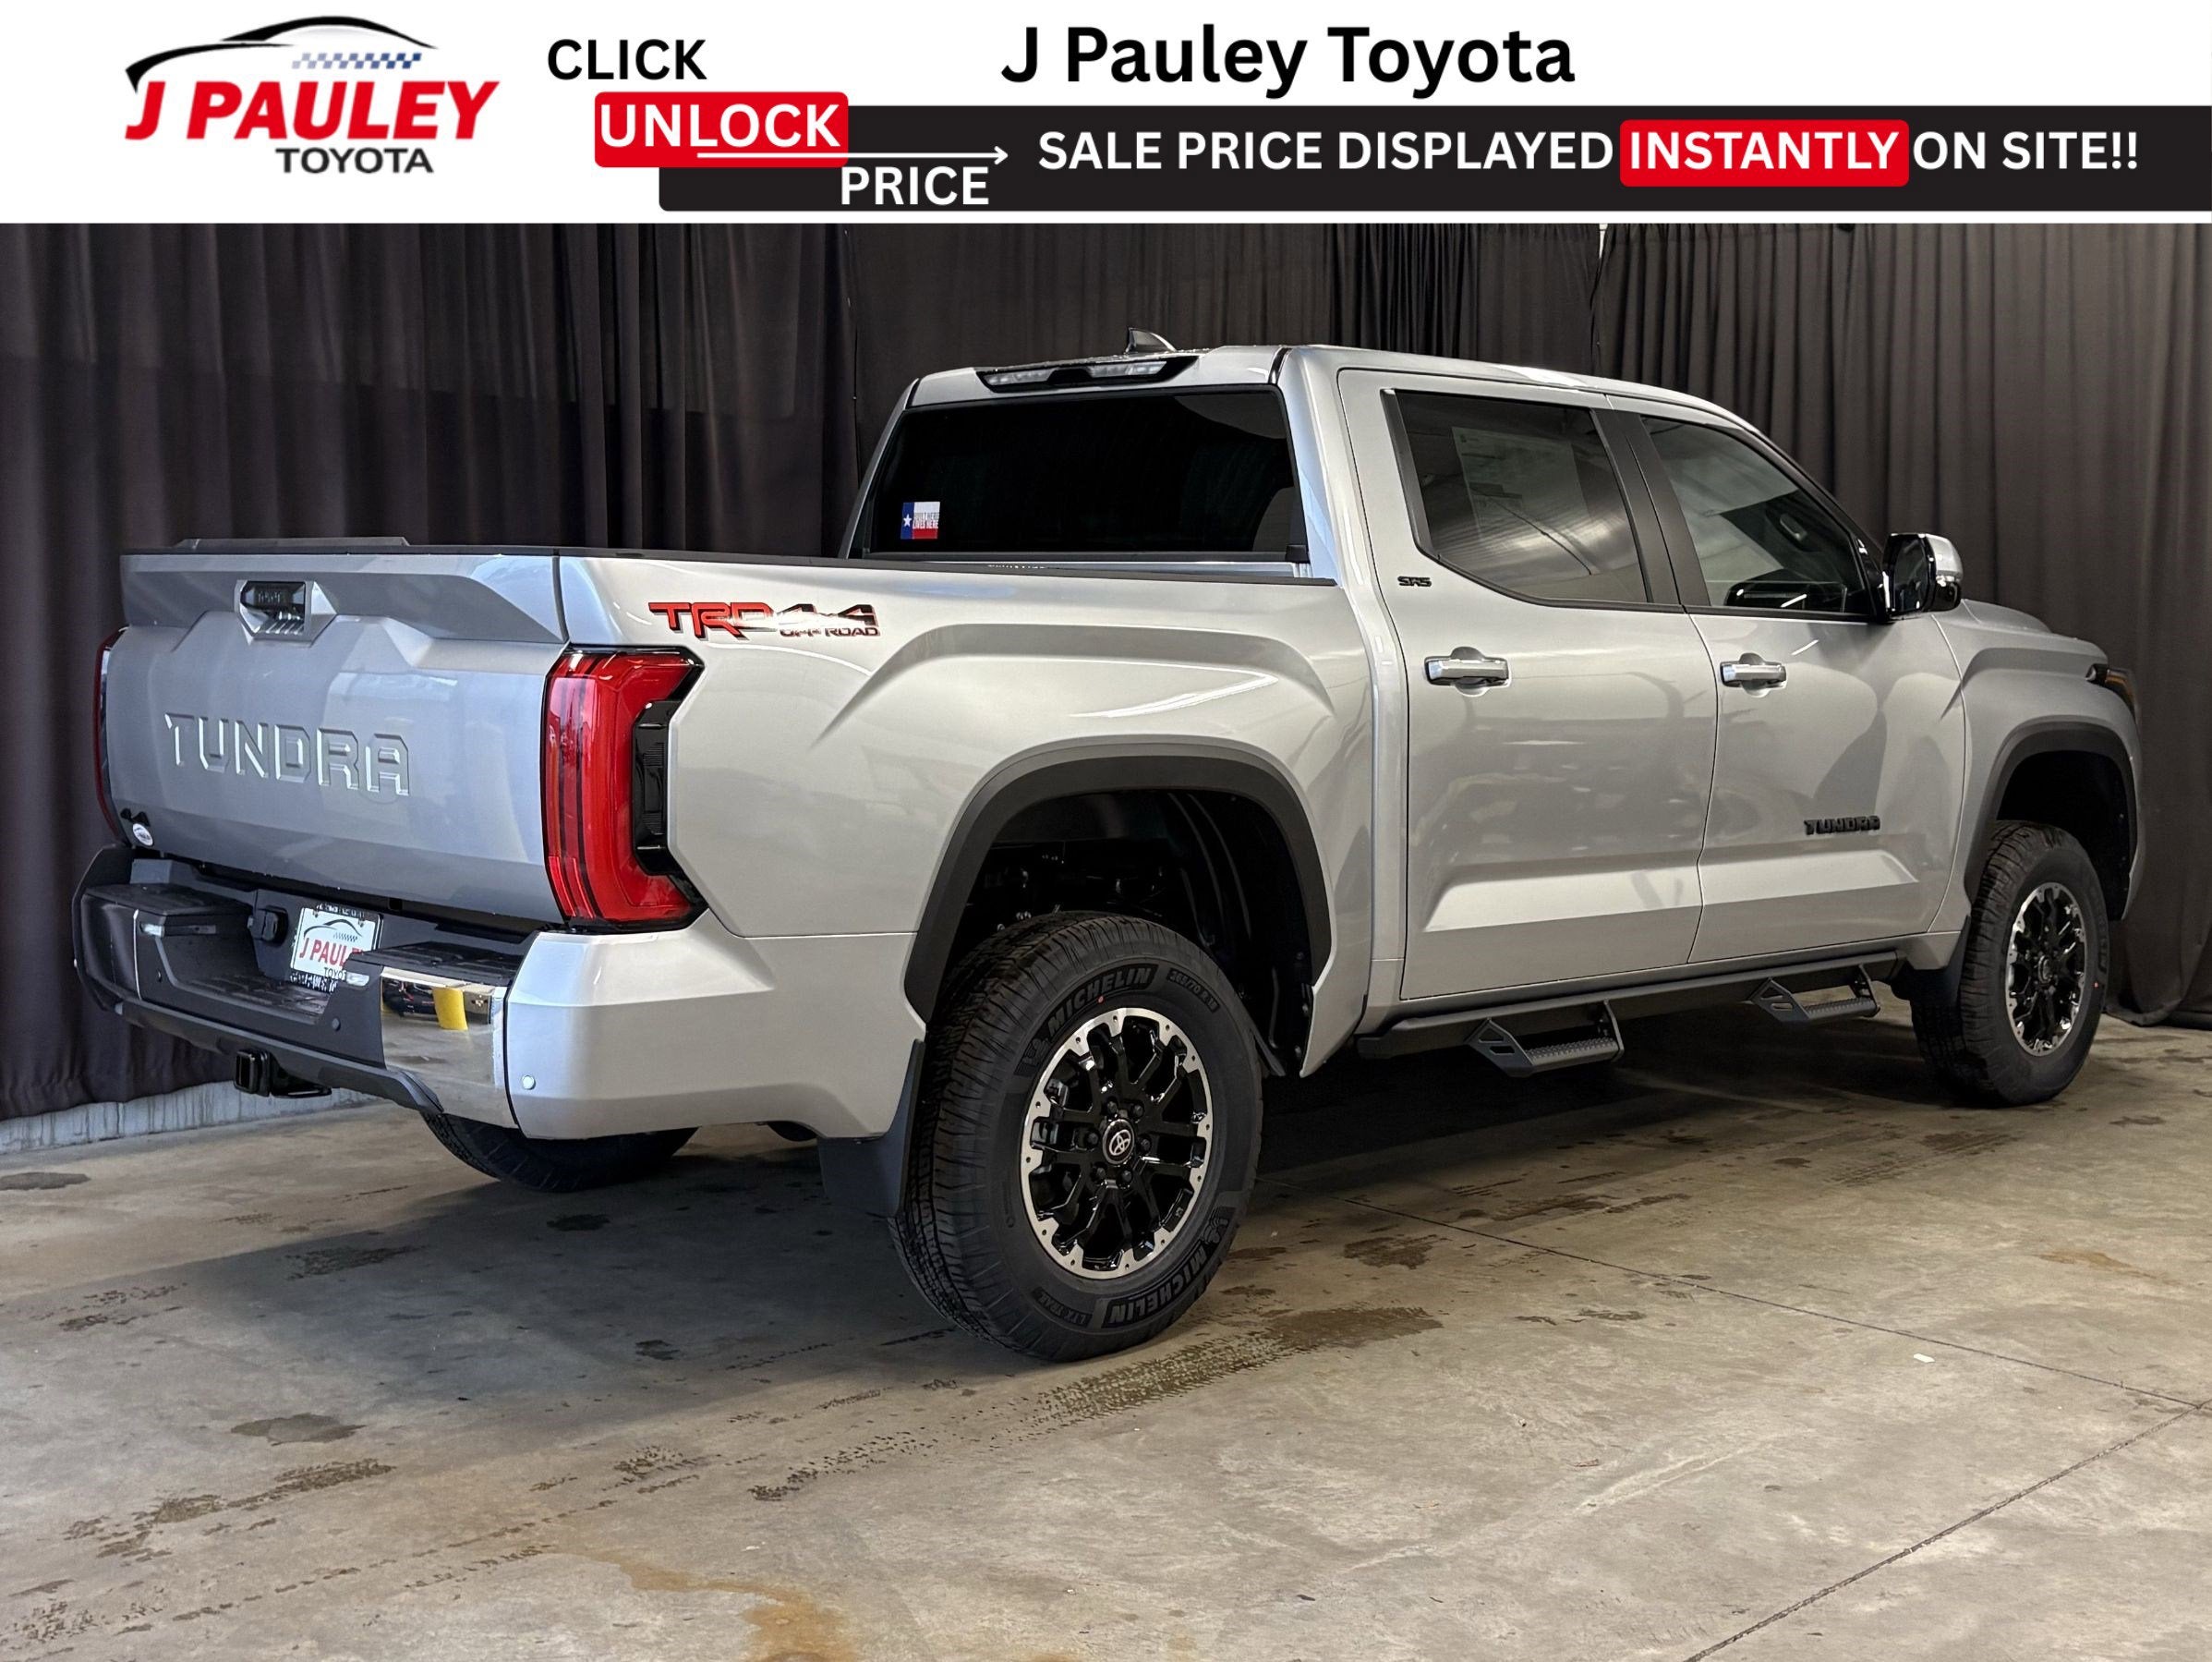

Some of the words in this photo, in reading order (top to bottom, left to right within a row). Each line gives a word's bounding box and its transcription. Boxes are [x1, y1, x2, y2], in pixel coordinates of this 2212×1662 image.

[648, 601, 778, 641] TRD
[824, 626, 881, 638] ROAD
[164, 712, 410, 796] TUNDRA
[1803, 815, 1881, 836] TUNDRA
[299, 937, 310, 959] J
[309, 939, 364, 967] PAUL
[1046, 966, 1152, 1038] MICHELIN
[1108, 1245, 1208, 1325] MICHELIN
